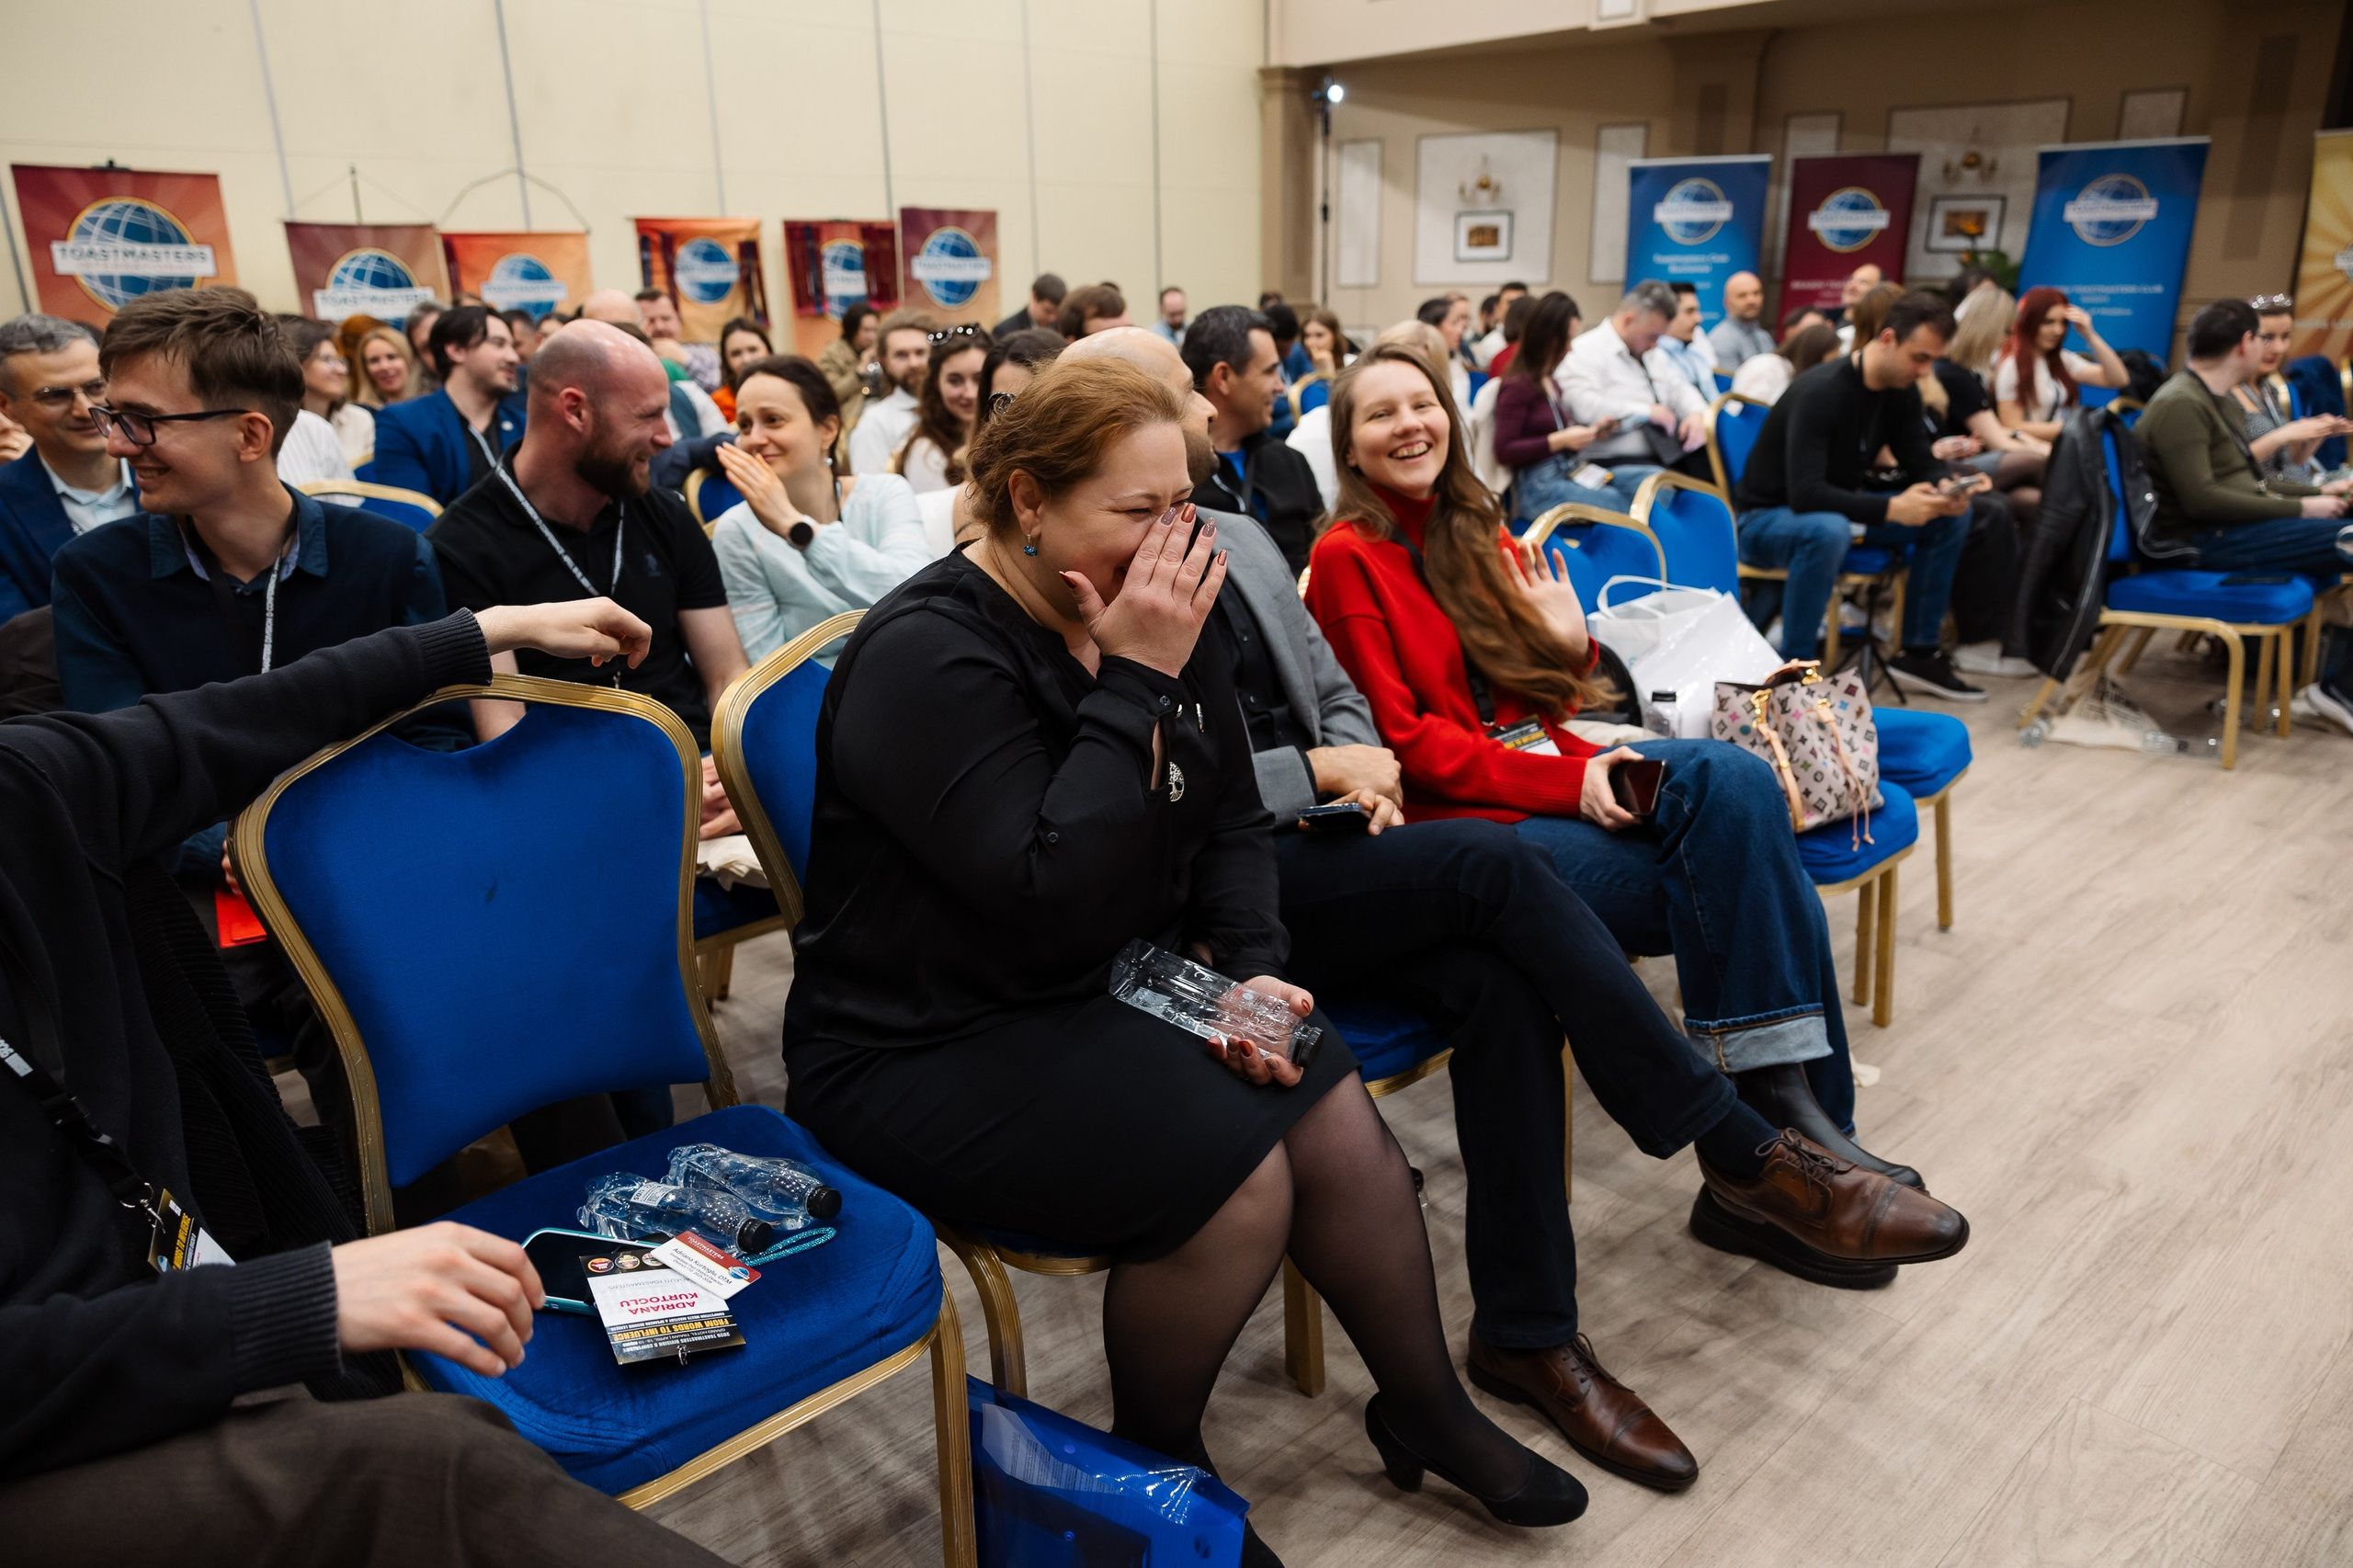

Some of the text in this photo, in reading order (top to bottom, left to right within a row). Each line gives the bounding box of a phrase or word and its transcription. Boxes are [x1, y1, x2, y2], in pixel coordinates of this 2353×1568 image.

[59, 246, 208, 262] TOASTMASTERS
[688, 1236, 724, 1259] TOASTMASTERS
[672, 1248, 694, 1262] Adriana
[718, 1275, 733, 1285] DTM
[608, 1279, 664, 1290] TOASTMASTERS
[628, 1301, 696, 1315] ADRIANA
[612, 1318, 730, 1341] FROM WORDS TO INFLUENCE
[658, 1339, 680, 1347] DIVISION
[680, 1334, 717, 1344] TOASTMASTERS
